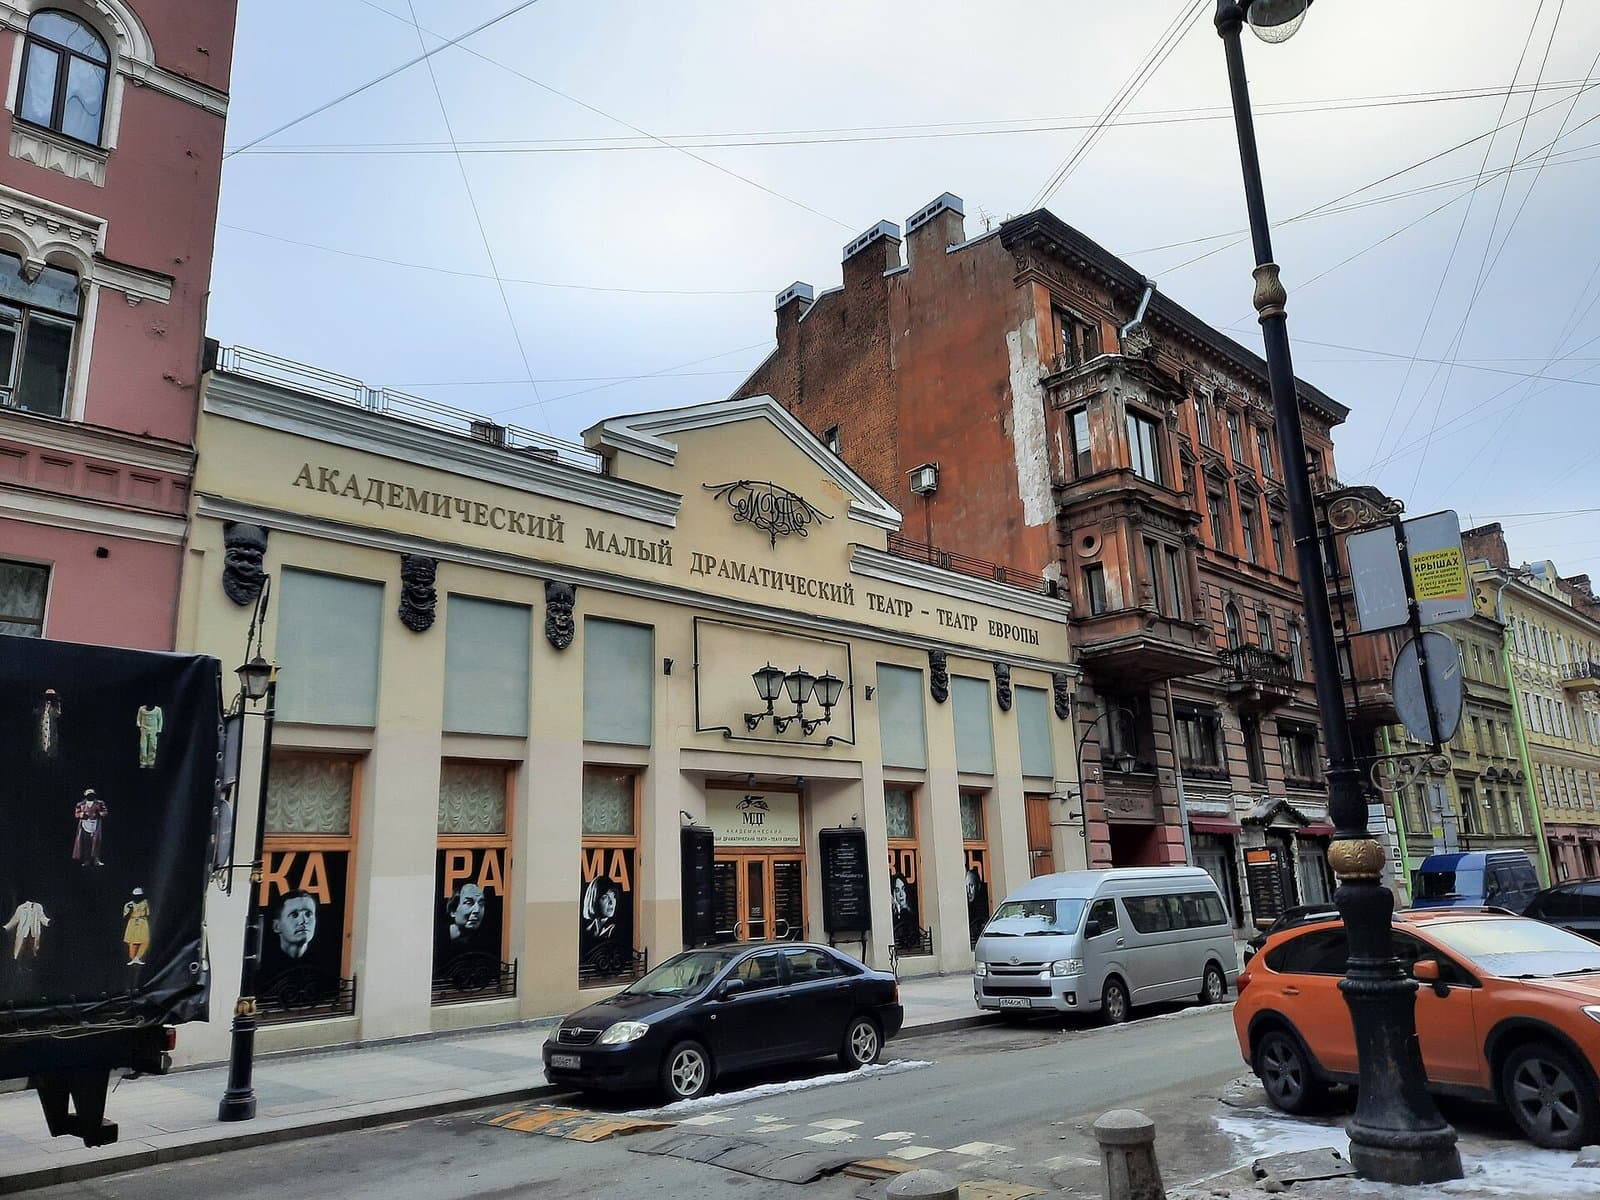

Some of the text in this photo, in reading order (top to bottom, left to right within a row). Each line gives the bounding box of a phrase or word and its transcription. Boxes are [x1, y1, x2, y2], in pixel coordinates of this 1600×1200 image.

[292, 462, 565, 544] АКАДЕМИЧЕСКИЙ
[584, 527, 673, 567] МАЛЫЙ
[690, 551, 855, 606] ДРАМАТИЧЕСКИЙ
[866, 592, 913, 619] ТЕАТР
[936, 608, 978, 632] ТЕАТР
[988, 619, 1040, 646] ЕВРОПЫ
[1414, 557, 1459, 572] КРЫШАХ
[742, 811, 766, 827] МДТ
[259, 851, 331, 907] КА
[444, 849, 504, 899] РА
